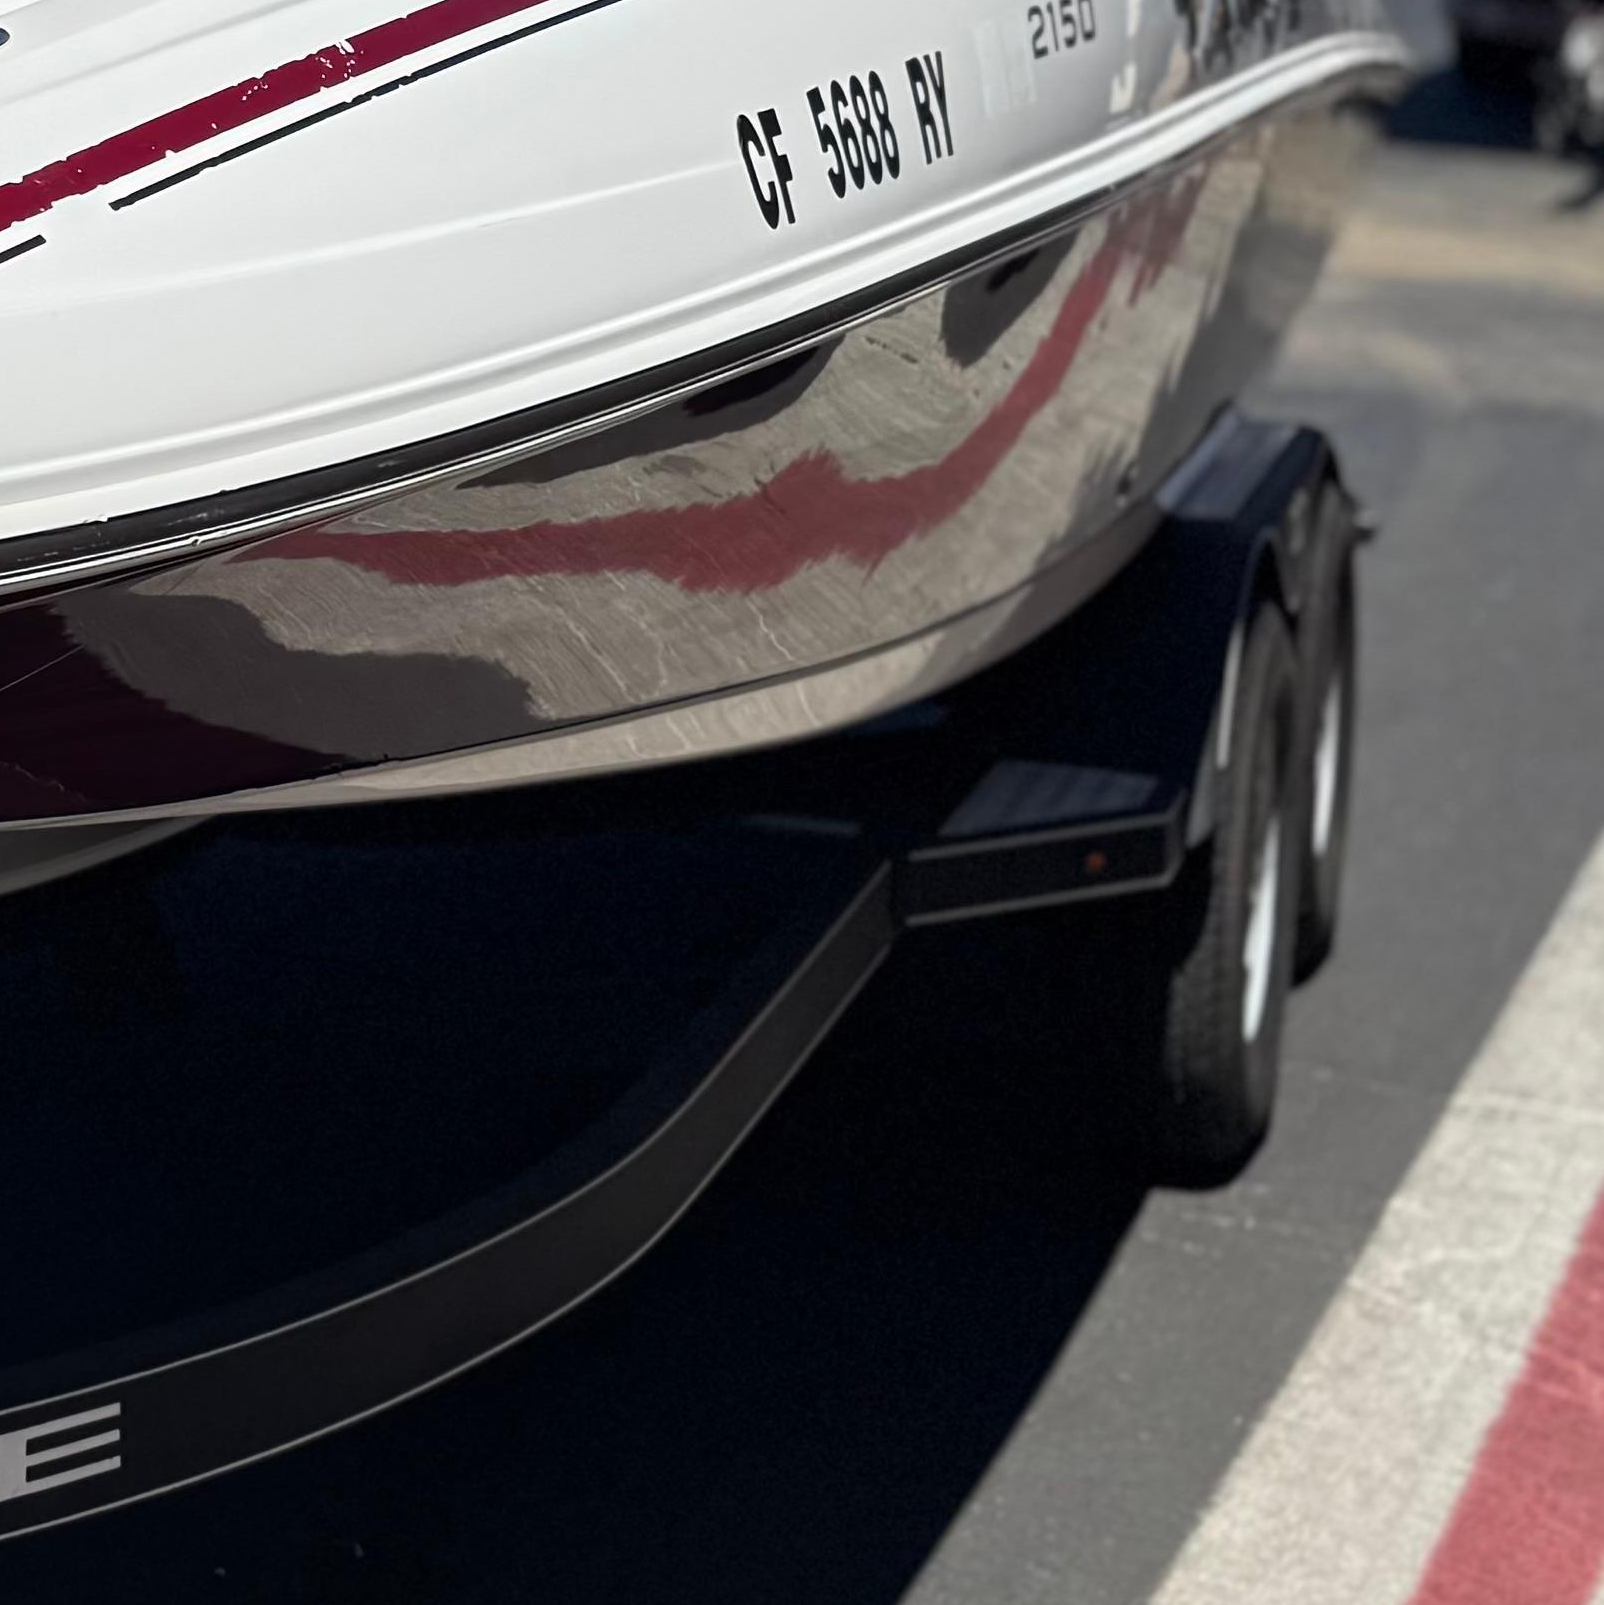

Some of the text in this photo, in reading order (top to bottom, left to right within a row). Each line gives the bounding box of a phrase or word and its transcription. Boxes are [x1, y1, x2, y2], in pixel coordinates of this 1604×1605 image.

[736, 50, 954, 230] CF 5688 RY
